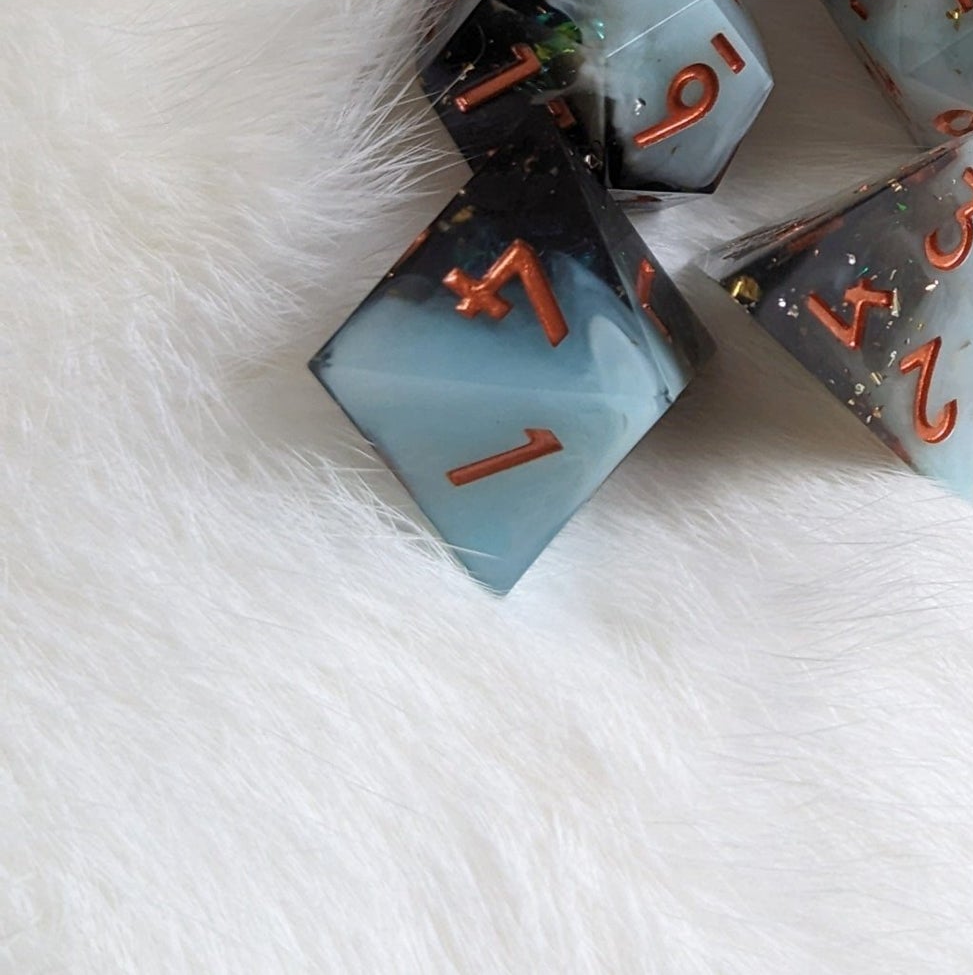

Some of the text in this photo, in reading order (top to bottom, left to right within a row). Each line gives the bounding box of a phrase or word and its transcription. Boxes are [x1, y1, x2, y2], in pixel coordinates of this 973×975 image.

[442, 237, 569, 348] 4
[807, 276, 895, 351] 4
[899, 335, 959, 445] 2
[445, 428, 564, 487] 1
